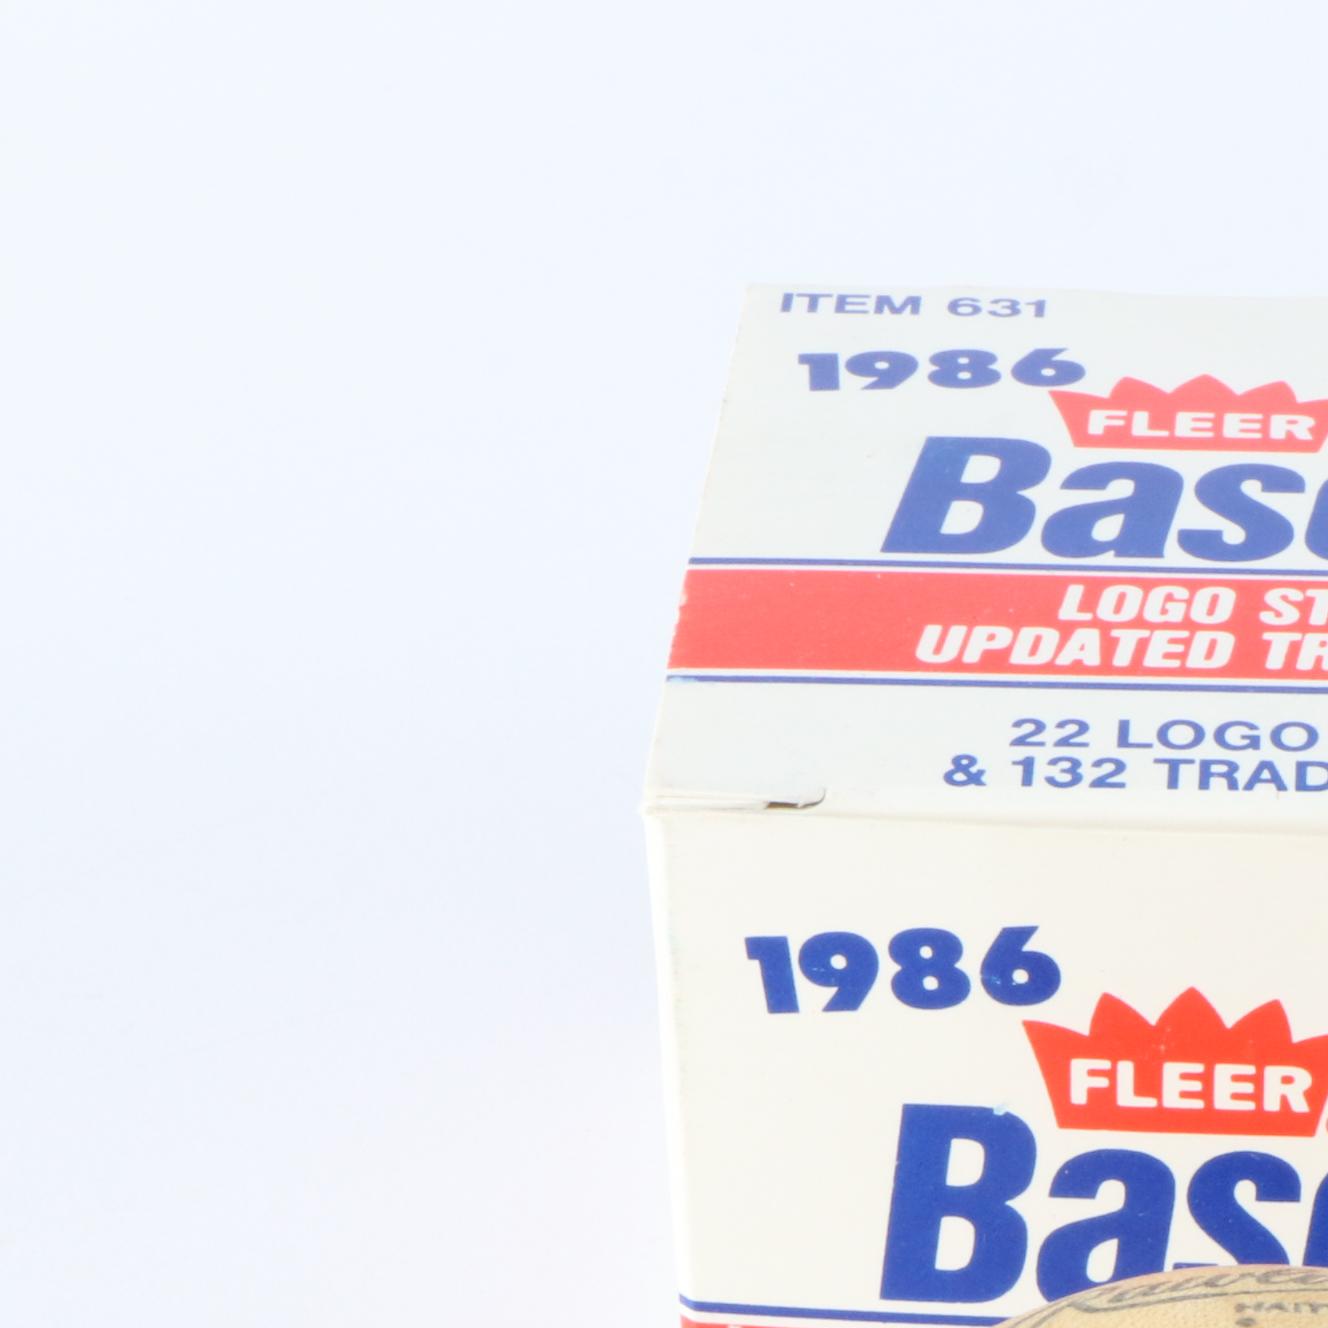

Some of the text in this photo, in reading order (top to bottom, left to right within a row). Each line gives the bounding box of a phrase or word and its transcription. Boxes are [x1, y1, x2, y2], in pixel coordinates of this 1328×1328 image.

[780, 290, 1049, 319] ITEM 631
[797, 346, 1087, 392] 1986
[1086, 408, 1317, 441] FLEER
[1057, 583, 1238, 626] LOGO
[914, 624, 1236, 671] UPDATED
[1009, 717, 1091, 749] 22
[1115, 719, 1320, 753] LOGO
[942, 752, 988, 787] &
[1010, 754, 1129, 790] 132
[744, 924, 1063, 1014] 1986
[1069, 1057, 1313, 1114] FLEER
